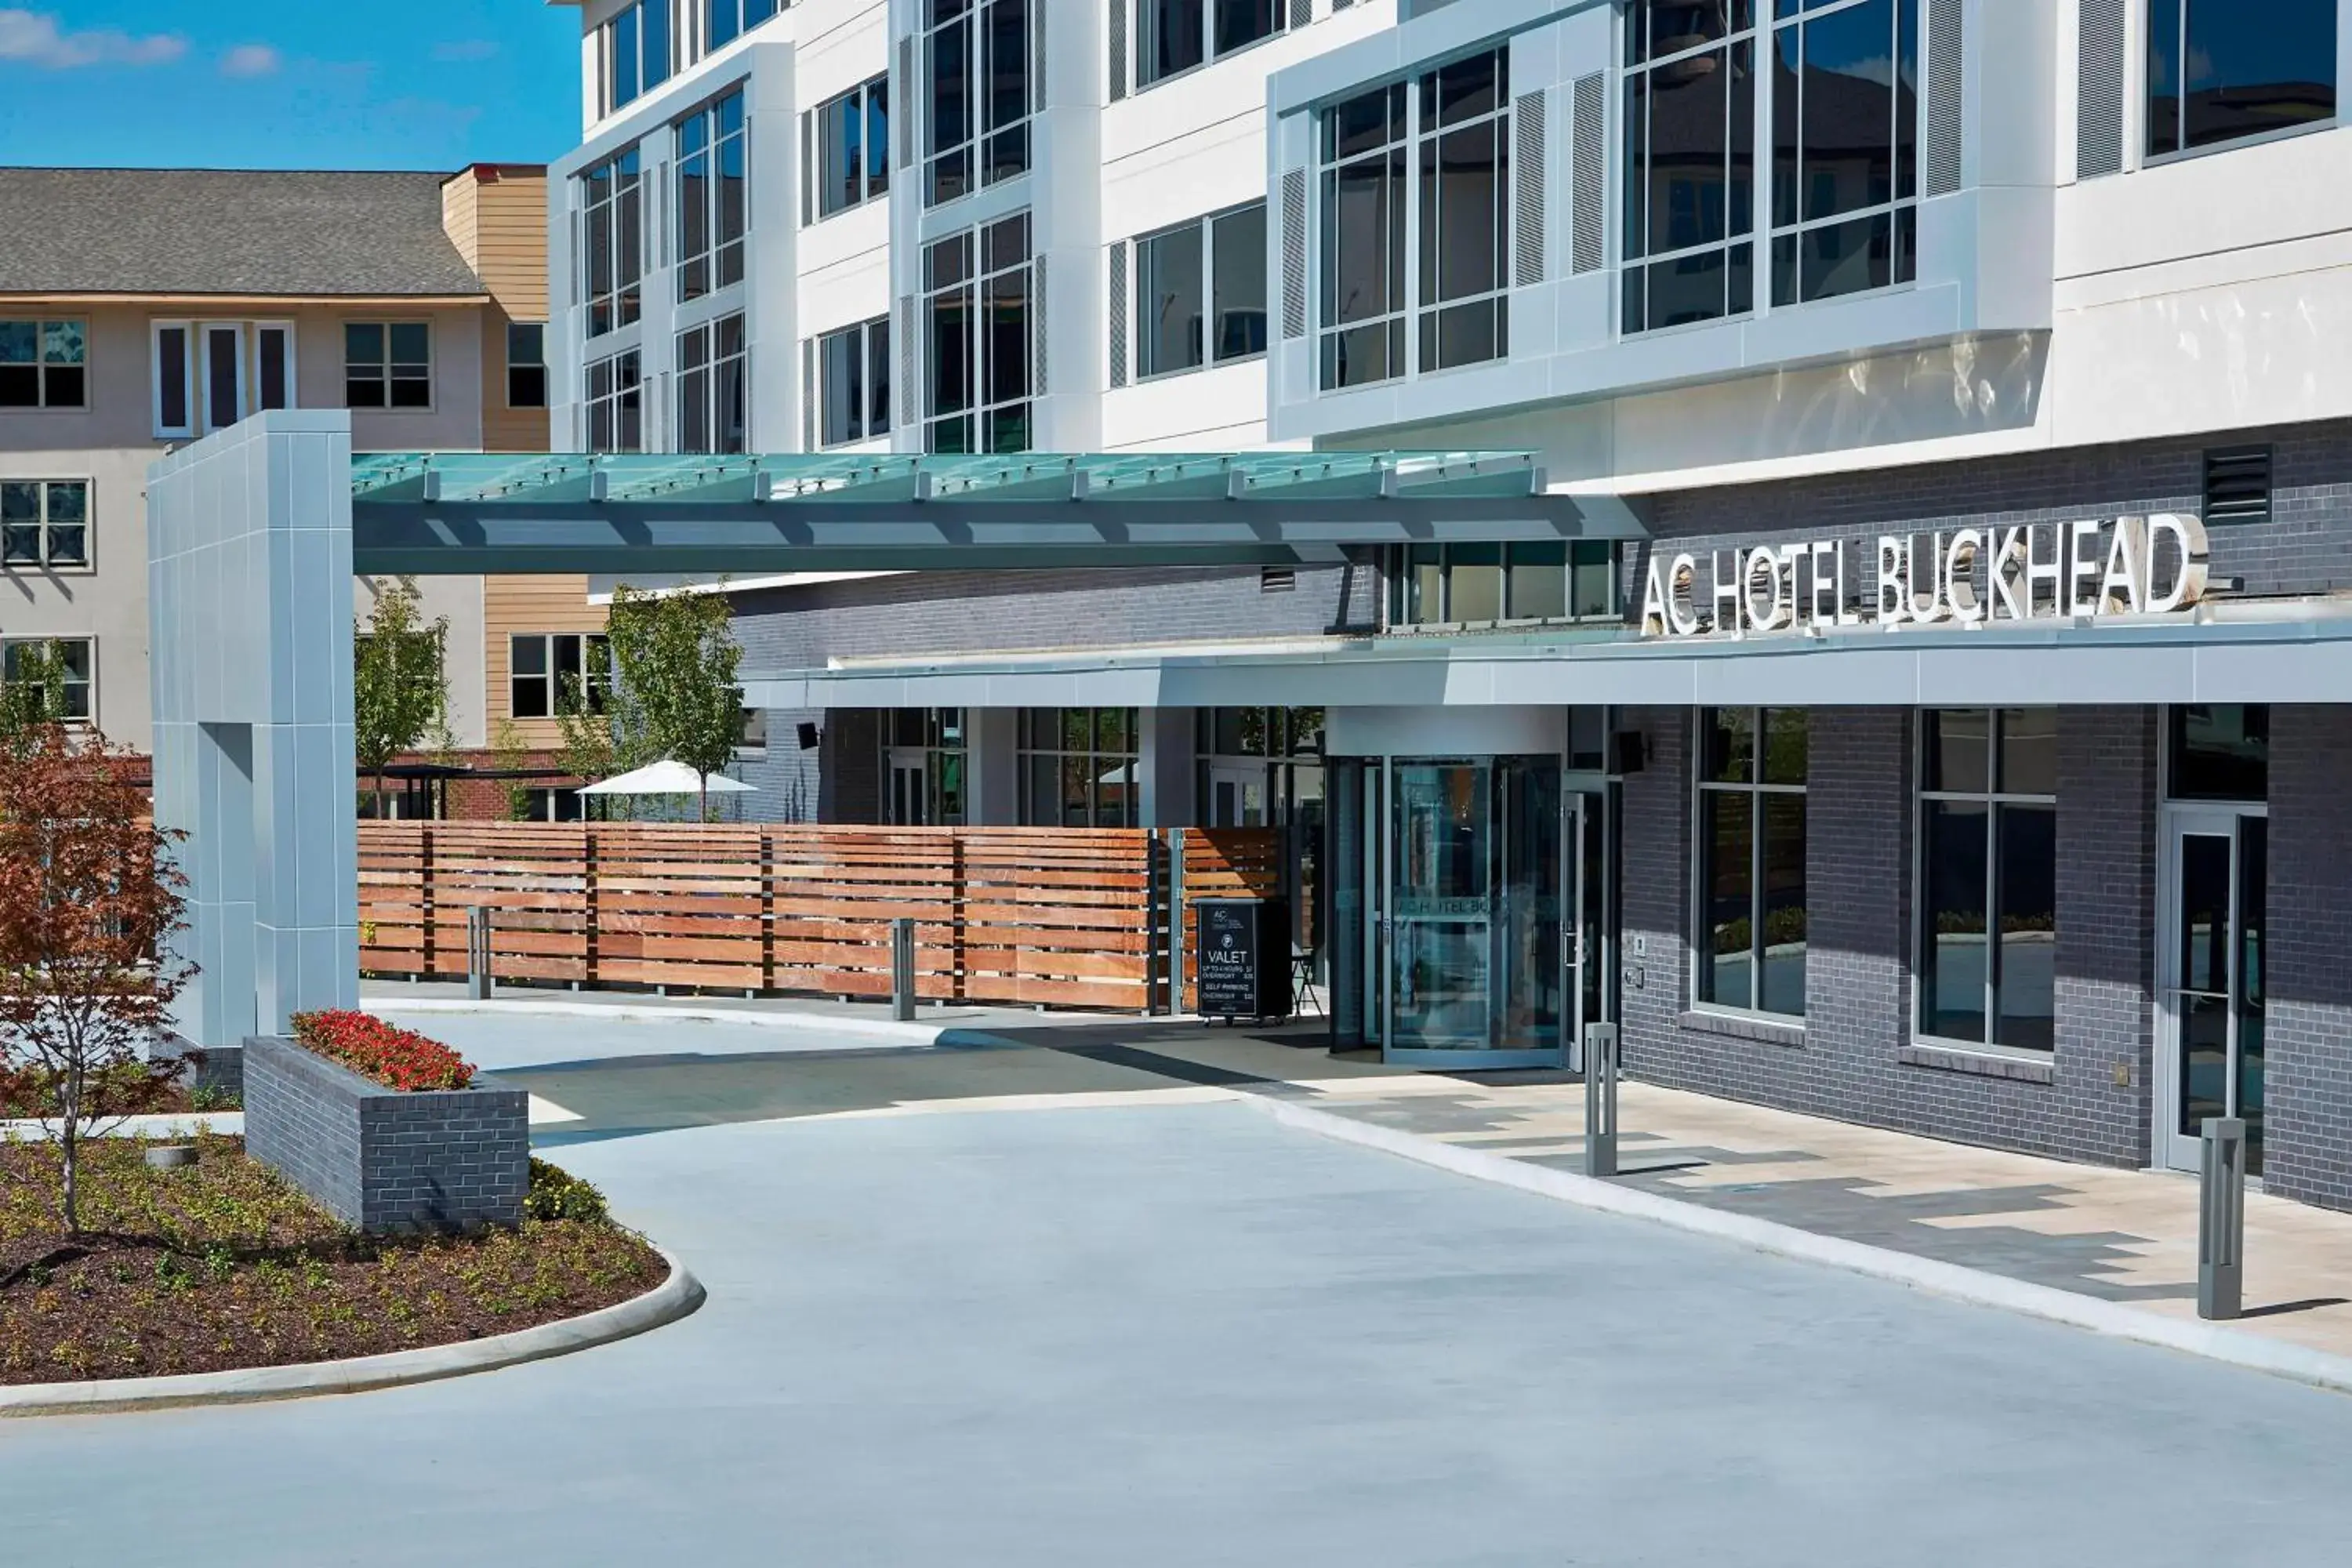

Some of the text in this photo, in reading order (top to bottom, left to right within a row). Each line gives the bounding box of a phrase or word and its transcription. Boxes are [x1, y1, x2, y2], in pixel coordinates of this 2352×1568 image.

[1640, 514, 2208, 636] AC HOTEL BUCKHEAD
[1207, 950, 1247, 964] VALET
